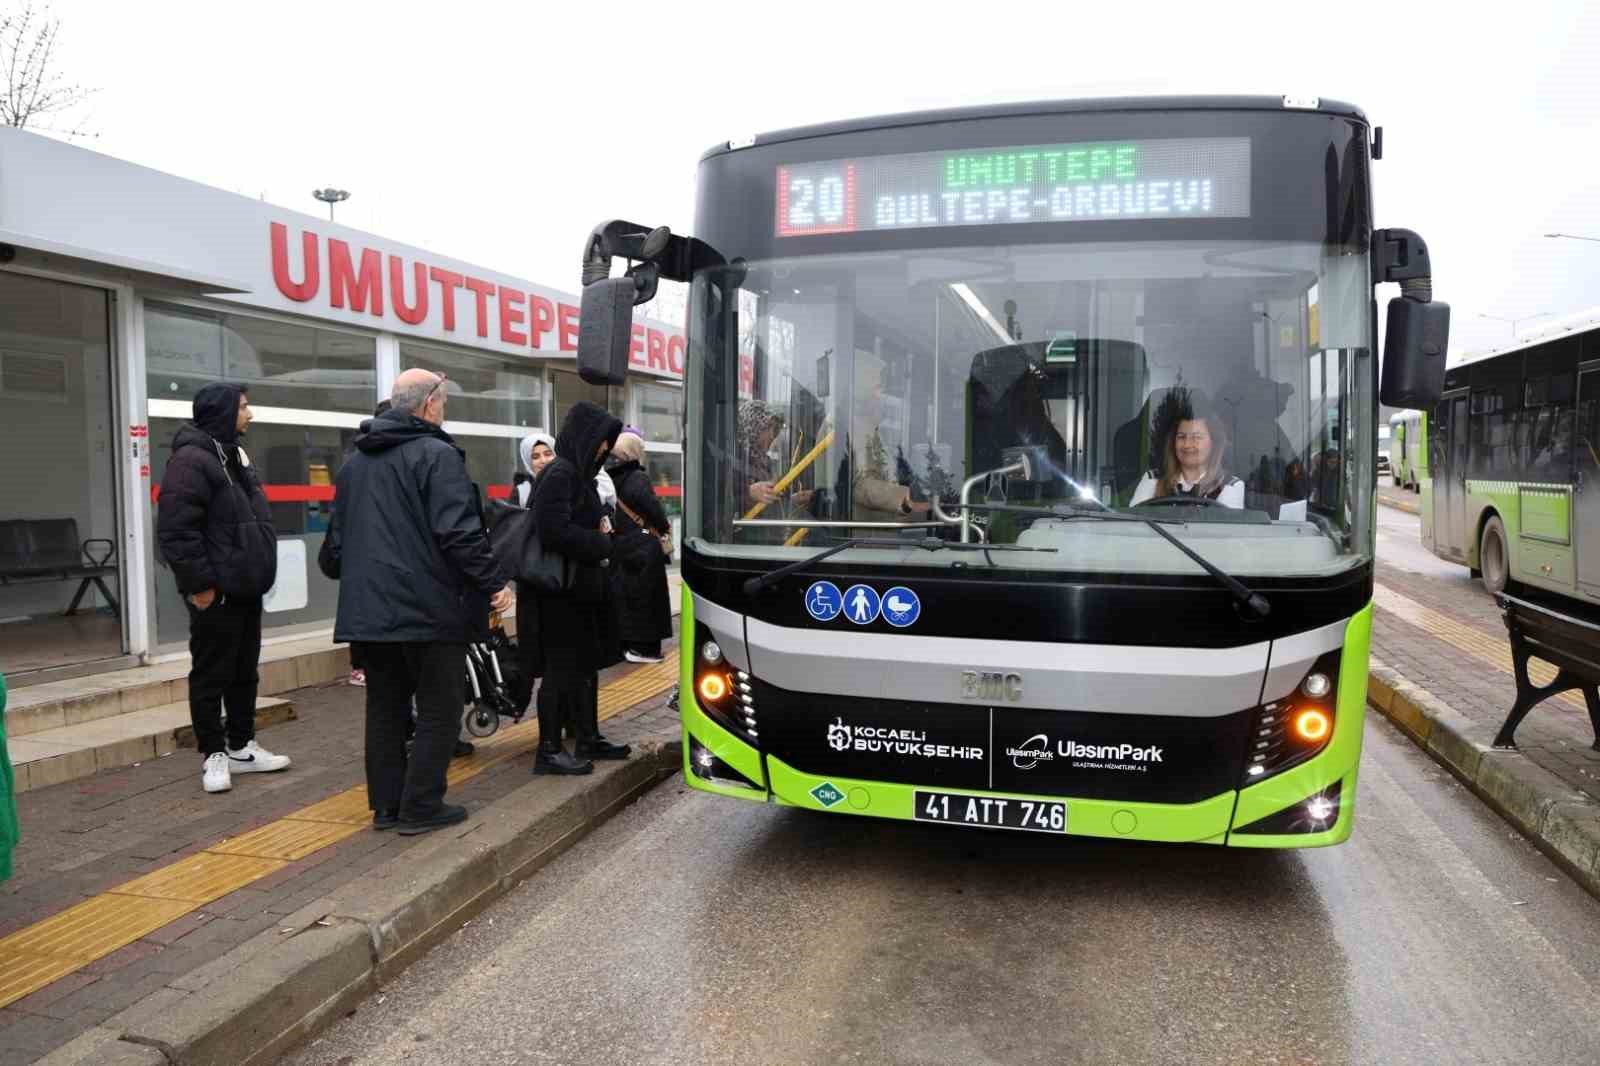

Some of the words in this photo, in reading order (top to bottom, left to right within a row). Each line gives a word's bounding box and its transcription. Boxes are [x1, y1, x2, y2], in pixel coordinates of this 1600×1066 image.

[946, 145, 1137, 187] UMUTTEPE
[789, 176, 844, 224] 20
[270, 221, 581, 351] UMUTTEPE
[960, 670, 1023, 702] BMC
[818, 789, 837, 801] CNG
[926, 795, 949, 820] 41
[965, 798, 1008, 825] ATT
[1020, 801, 1064, 830] 746
